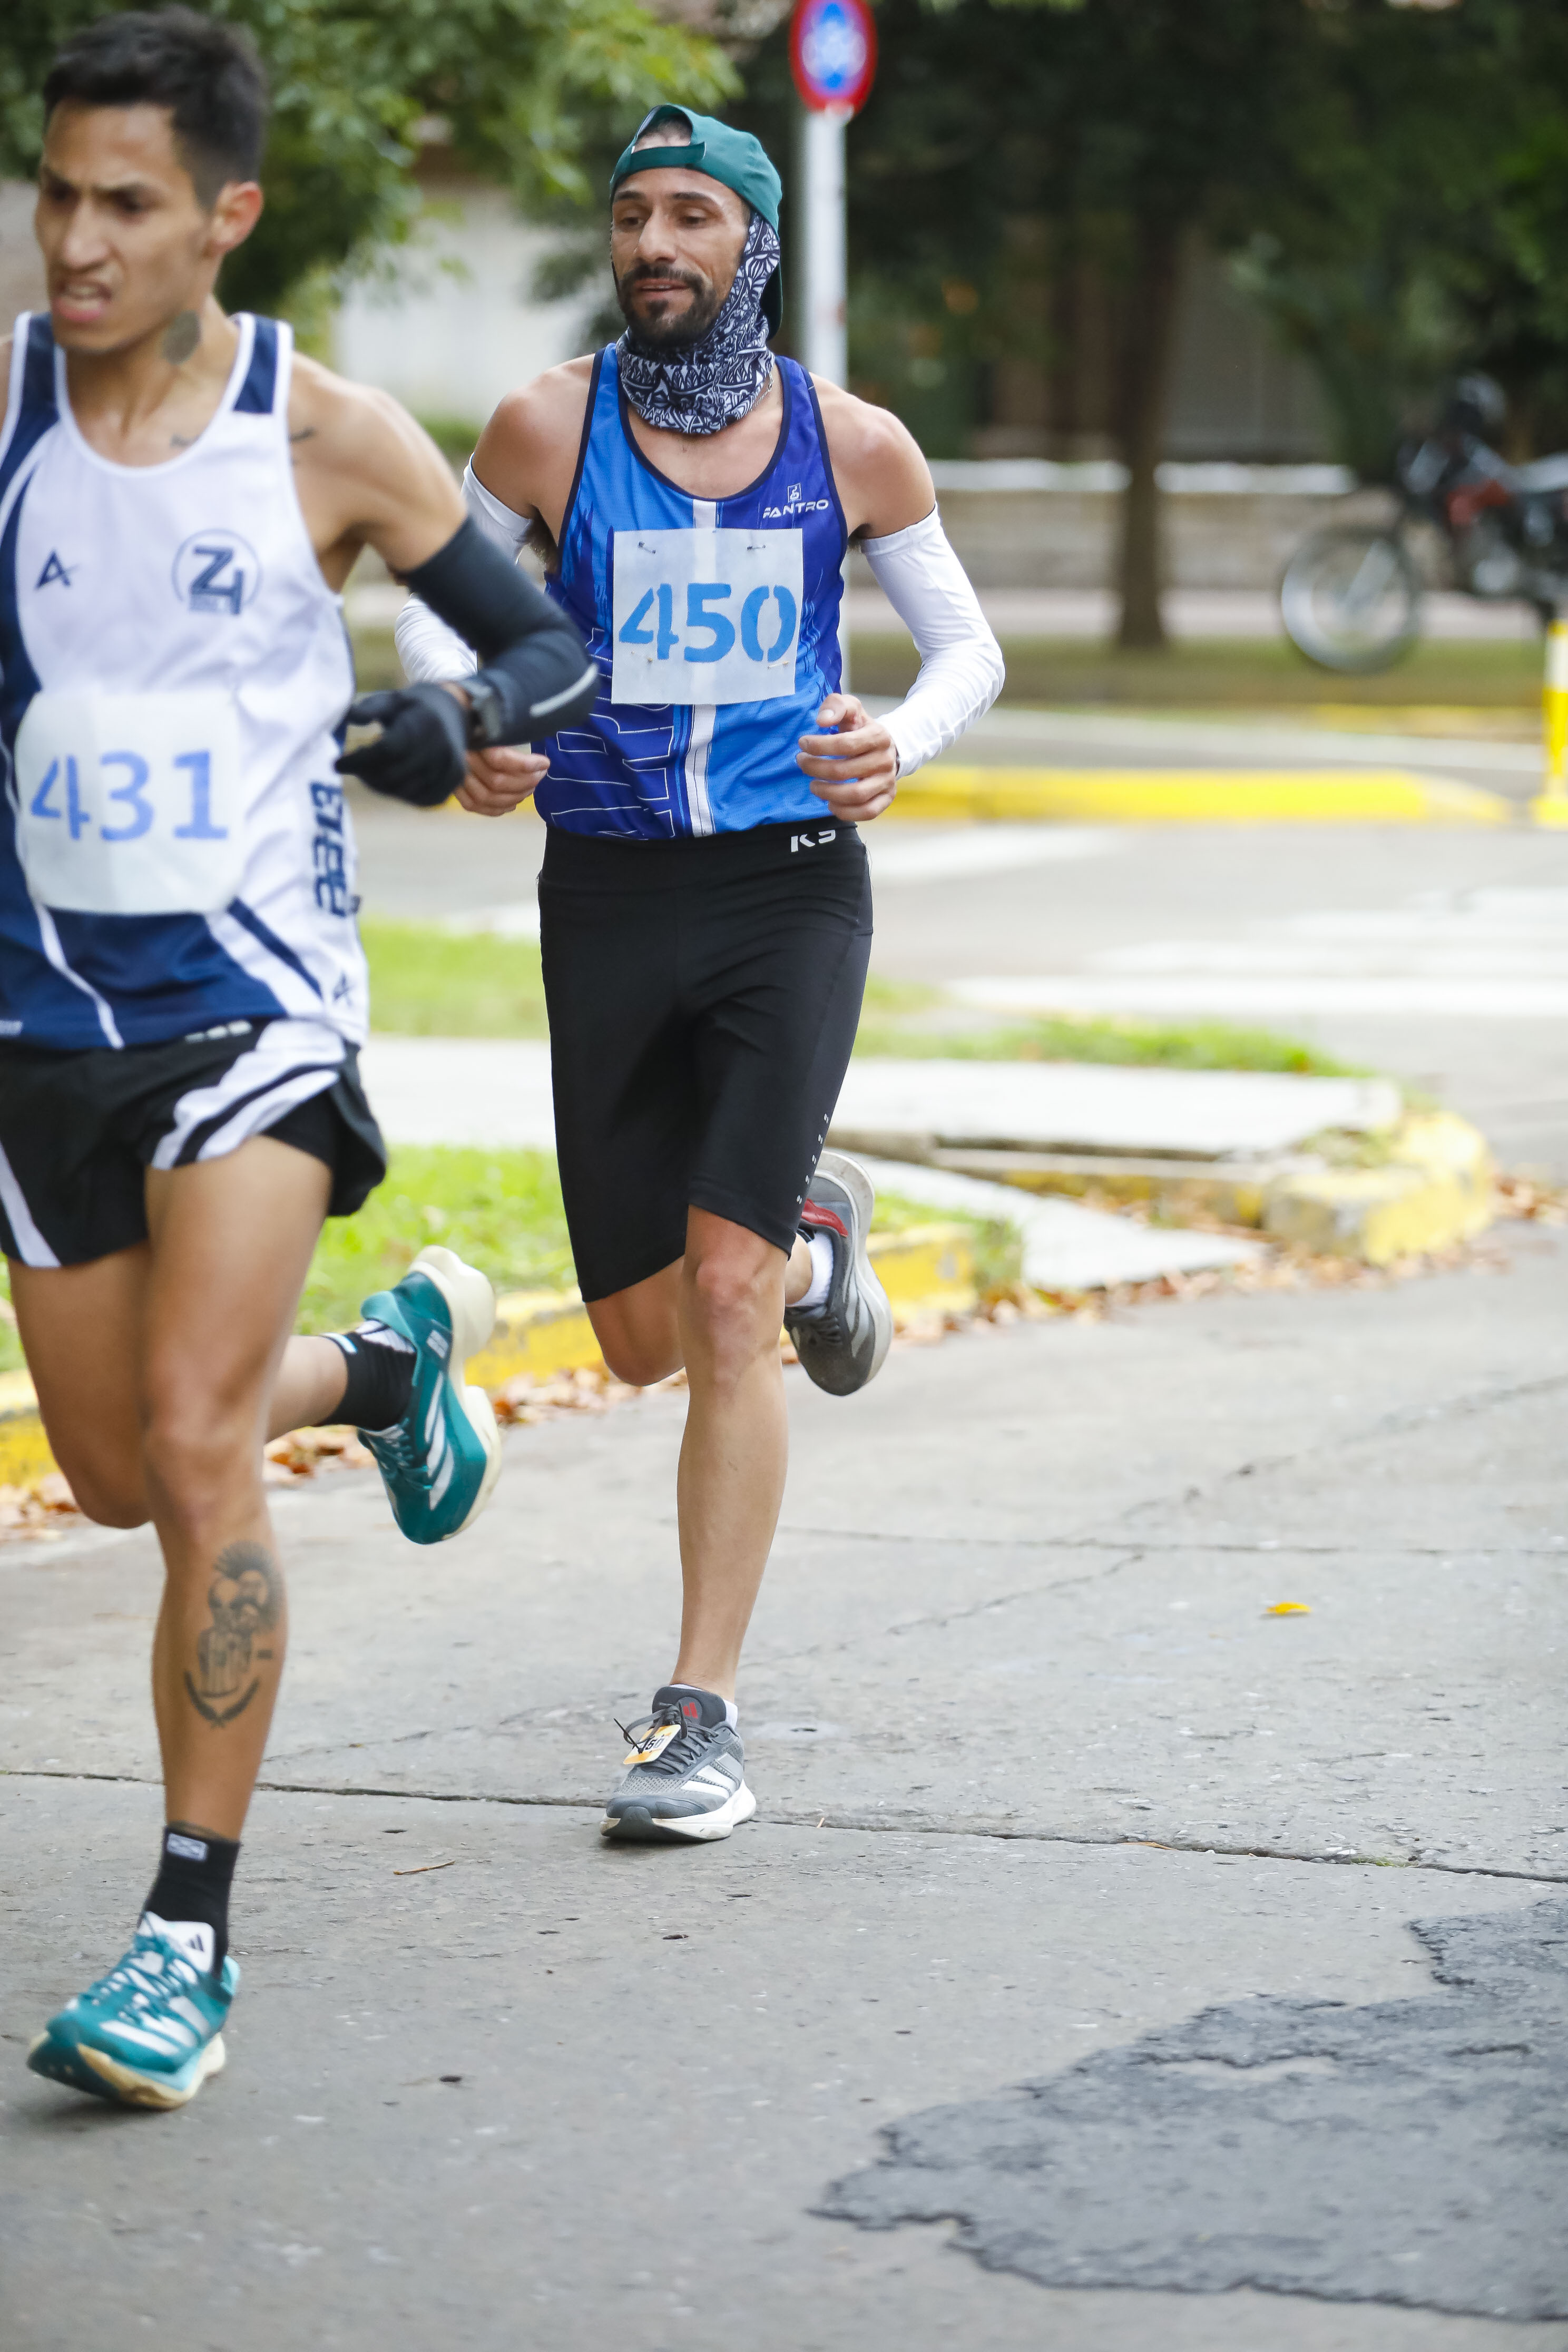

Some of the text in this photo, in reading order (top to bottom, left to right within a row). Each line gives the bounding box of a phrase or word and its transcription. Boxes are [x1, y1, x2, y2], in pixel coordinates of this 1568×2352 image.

[762, 499, 829, 519] FANTRO
[619, 583, 797, 663] 450
[31, 750, 229, 841] 431
